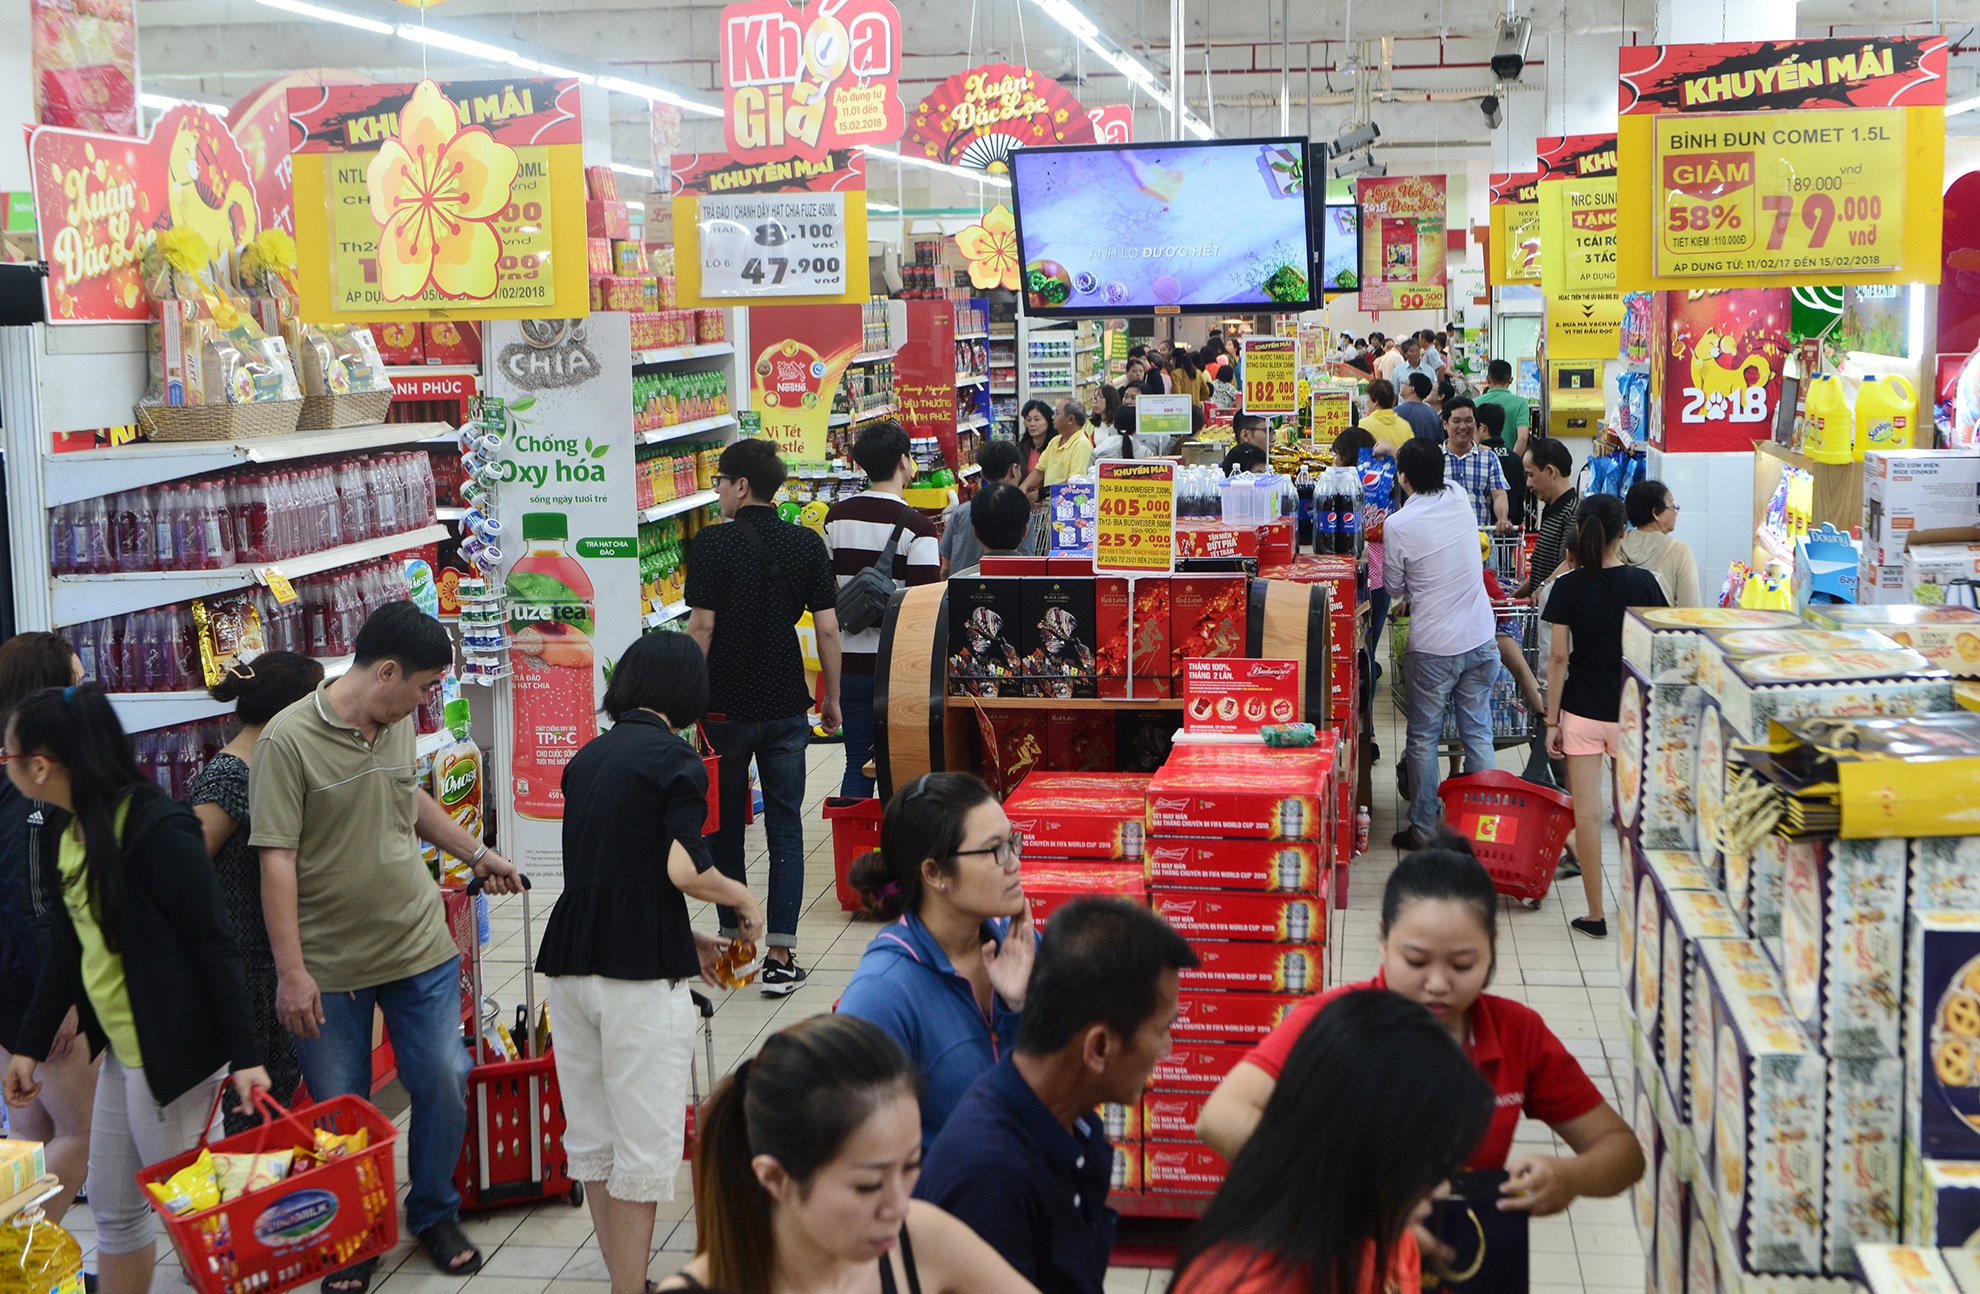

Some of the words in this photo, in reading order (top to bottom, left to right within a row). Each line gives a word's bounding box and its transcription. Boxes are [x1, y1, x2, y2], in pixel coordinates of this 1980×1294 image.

[1685, 53, 1823, 105] KHUYẾN
[1826, 44, 1895, 86] MÃI
[963, 72, 1029, 104] Xuân
[472, 85, 534, 123] MÃI
[836, 88, 849, 104] Áp
[850, 90, 871, 105] dụng
[873, 88, 883, 101] từ
[842, 105, 861, 116] 11.01
[862, 104, 878, 115] đến
[951, 101, 1000, 131] Đắc
[999, 91, 1047, 122] Lộc
[839, 117, 882, 132] 15.02.2018
[1670, 131, 1717, 150] BÌNH
[1723, 130, 1766, 147] ĐUN
[1772, 127, 1845, 145] COMET
[1851, 126, 1890, 142] 1.5L
[1672, 160, 1750, 184] GIẢM
[1785, 176, 1842, 192] 189.000
[64, 168, 136, 226] Xuân
[1571, 193, 1592, 207] NRC
[734, 206, 756, 218] CHANH
[785, 205, 801, 217] CHIA
[801, 205, 818, 217] FUZE
[818, 205, 838, 217] 450ML
[1668, 203, 1741, 232] 58%
[1762, 194, 1882, 250] 79.000
[1584, 233, 1603, 247] CÁI
[54, 215, 111, 287] Đắc
[1089, 248, 1119, 260] ANH
[1121, 248, 1140, 260] LO
[1142, 246, 1190, 261] ĐƯỢC
[1191, 242, 1223, 259] HẾT
[1585, 253, 1591, 263] 3
[741, 257, 841, 285] 47.900
[1673, 261, 1690, 272] ÁP
[1691, 261, 1722, 273] DỤNG
[1724, 257, 1744, 270] TỪ:
[1746, 258, 1790, 269] 11/02/17
[1794, 255, 1818, 268] ĐẾN
[1820, 255, 1880, 267] 15/02/2018
[1580, 273, 1591, 281] ÁP
[1592, 271, 1616, 282] DỤNG
[346, 289, 362, 302] ÁP
[509, 350, 591, 376] CHIA
[422, 378, 463, 396] PHÚC
[777, 383, 806, 393] Nestlé
[1247, 381, 1294, 402] 182.000
[920, 399, 952, 408] THƯƠNG
[930, 410, 951, 421] PHÚC
[765, 425, 779, 439] Vị
[783, 423, 802, 438] Tết
[515, 433, 579, 457] Chống
[500, 459, 548, 489] Oxy
[555, 458, 606, 483] hóa
[1113, 465, 1149, 477] KHUYẾN
[1124, 486, 1154, 494] BUDWEISER
[530, 494, 551, 505] sống
[552, 493, 573, 505] ngày
[575, 494, 593, 504] tươi
[1099, 498, 1171, 516] 405.000
[1114, 518, 1122, 526] BIA
[1124, 519, 1155, 527] BUDWEISER
[585, 538, 599, 548] TRÀ
[599, 540, 611, 550] HẠT
[612, 540, 629, 548] CHIA
[1099, 533, 1171, 548] 259.000
[1222, 537, 1238, 548] PHÁ
[1811, 532, 1849, 548] Downy
[599, 546, 615, 557] ĐÀO
[506, 601, 587, 622] fuzetea
[1211, 663, 1231, 671] 100%.
[1252, 667, 1291, 676] Budweiser
[526, 673, 542, 682] ĐÀO
[1213, 672, 1218, 680] 2
[517, 682, 532, 691] HẠT
[533, 681, 550, 689] CHIA
[536, 731, 578, 744] TPP-C
[536, 750, 548, 758] CHO
[549, 749, 563, 759] CUỘC
[1221, 871, 1240, 879] WORLD
